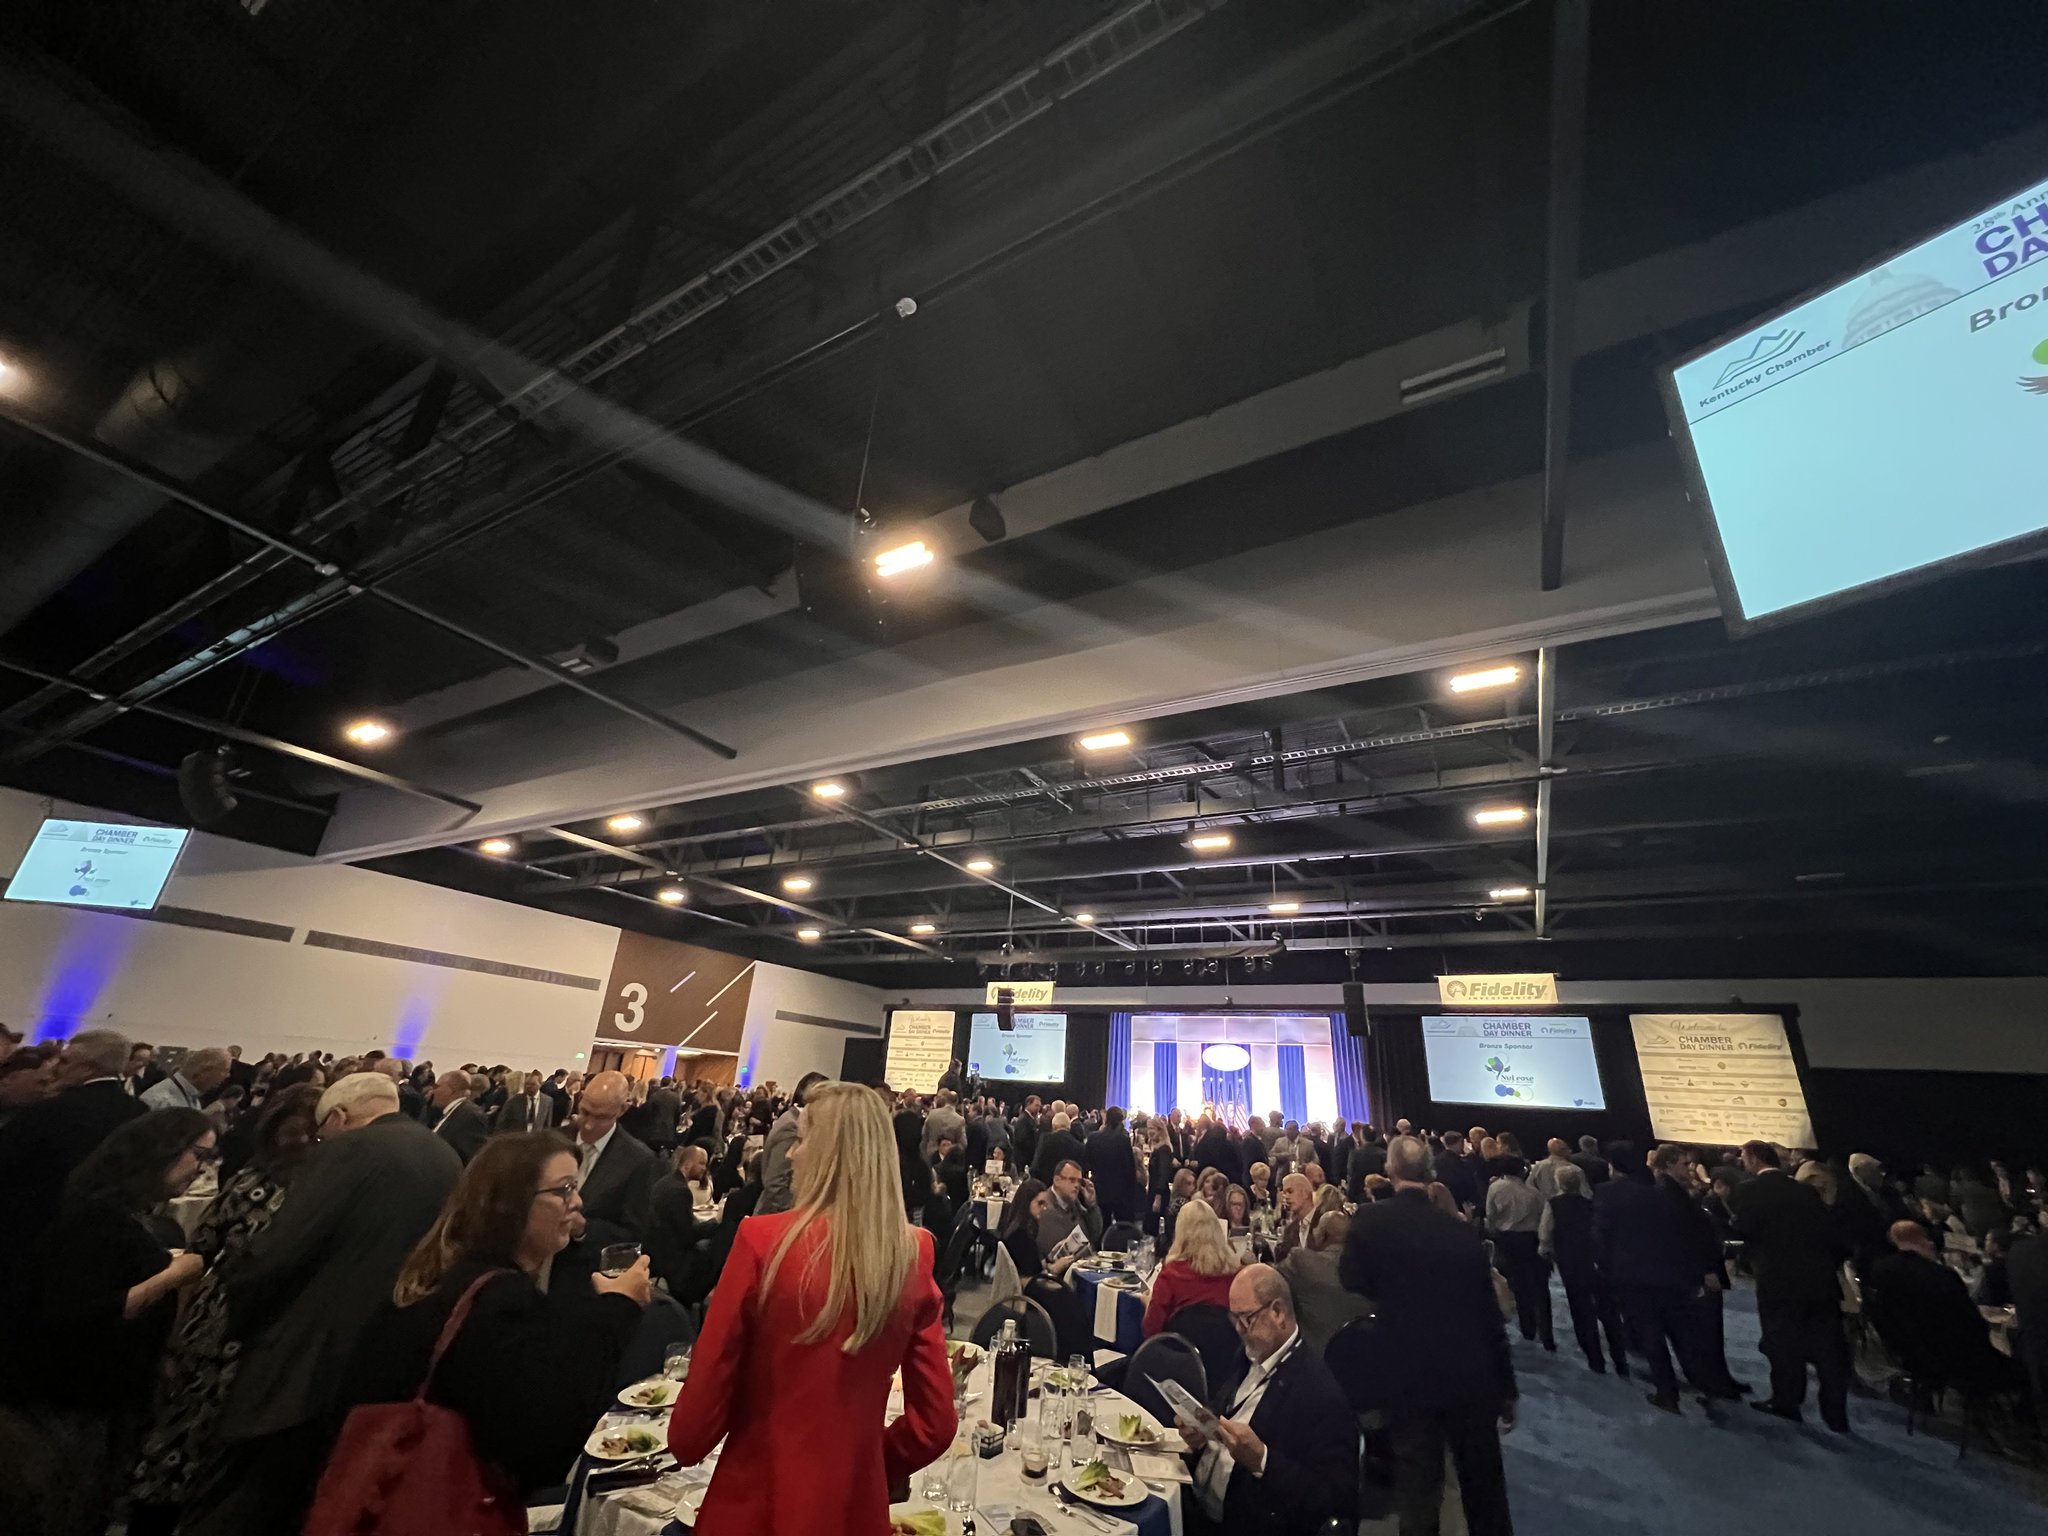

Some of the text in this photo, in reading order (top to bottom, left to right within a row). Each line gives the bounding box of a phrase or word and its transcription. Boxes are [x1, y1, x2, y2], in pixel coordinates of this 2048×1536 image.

[1983, 230, 2048, 278] DA
[1699, 340, 1831, 407] Kentucky Chamber
[95, 828, 138, 838] CHAMBER
[1469, 982, 1547, 999] Fidelity
[614, 982, 648, 1033] 3
[1482, 1022, 1531, 1030] CHAMBER
[1678, 1035, 1732, 1044] CHAMBER
